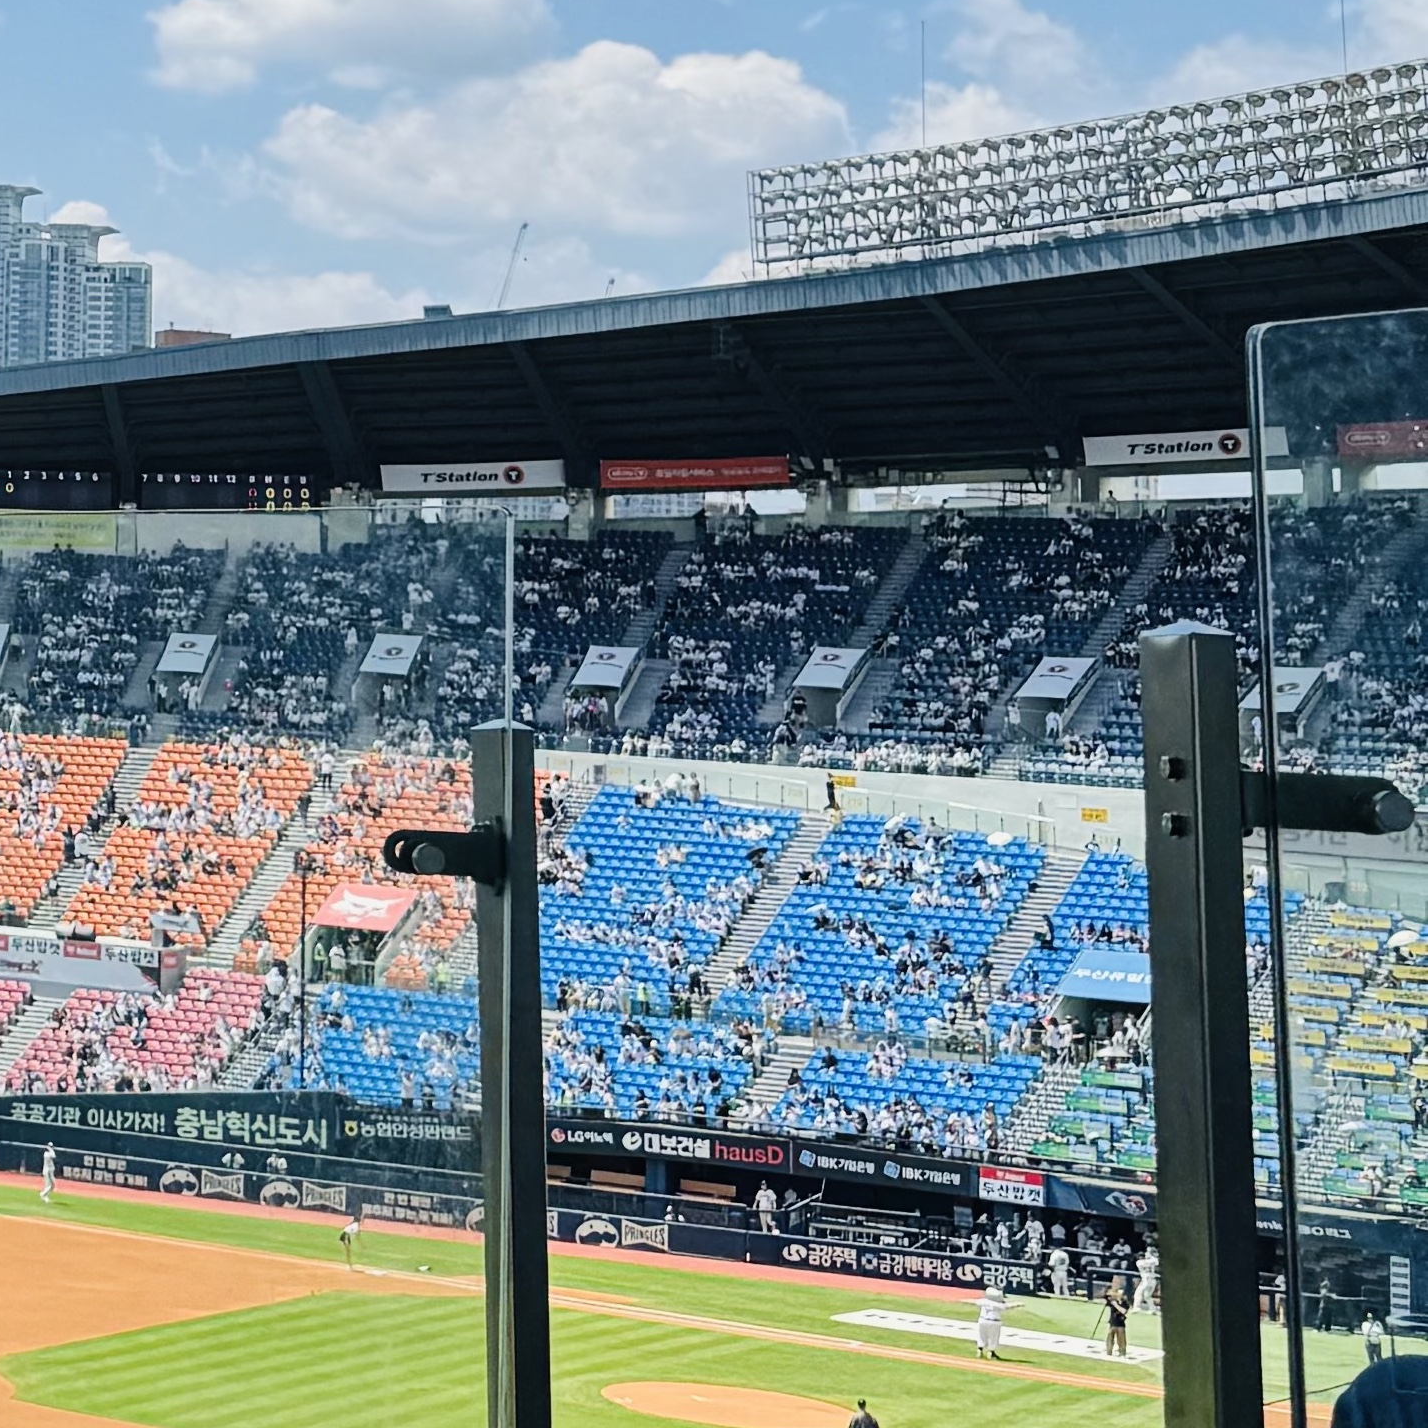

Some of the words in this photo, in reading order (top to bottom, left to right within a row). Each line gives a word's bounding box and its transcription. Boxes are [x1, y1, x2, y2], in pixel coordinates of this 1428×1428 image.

[5, 482, 14, 493] 0
[7, 470, 12, 479] 1
[24, 471, 30, 480] 2
[41, 471, 47, 480] 3
[58, 471, 64, 480] 4
[75, 472, 82, 481] 5
[92, 472, 99, 482] 6
[174, 473, 181, 484] 9
[191, 474, 201, 483] 10
[265, 487, 276, 499] 0
[283, 488, 293, 499] 0
[300, 488, 310, 499] 0
[12, 937, 60, 955] 두산밥캣
[10, 1101, 81, 1126] 공공기관
[87, 1108, 166, 1134] 이사가자!
[174, 1106, 328, 1150] 충남혁신도시
[644, 1132, 711, 1159] 대보건설
[714, 1139, 784, 1165] hausD
[816, 1155, 876, 1175] IBK기업은행
[901, 1165, 961, 1186] IBK기업은행
[305, 1183, 344, 1211] PRINGLES
[624, 1222, 665, 1246] PRINGLES
[808, 1242, 857, 1270] 금강주택
[878, 1252, 954, 1281] 금강펜테리움
[982, 1263, 1034, 1290] 금강주택
